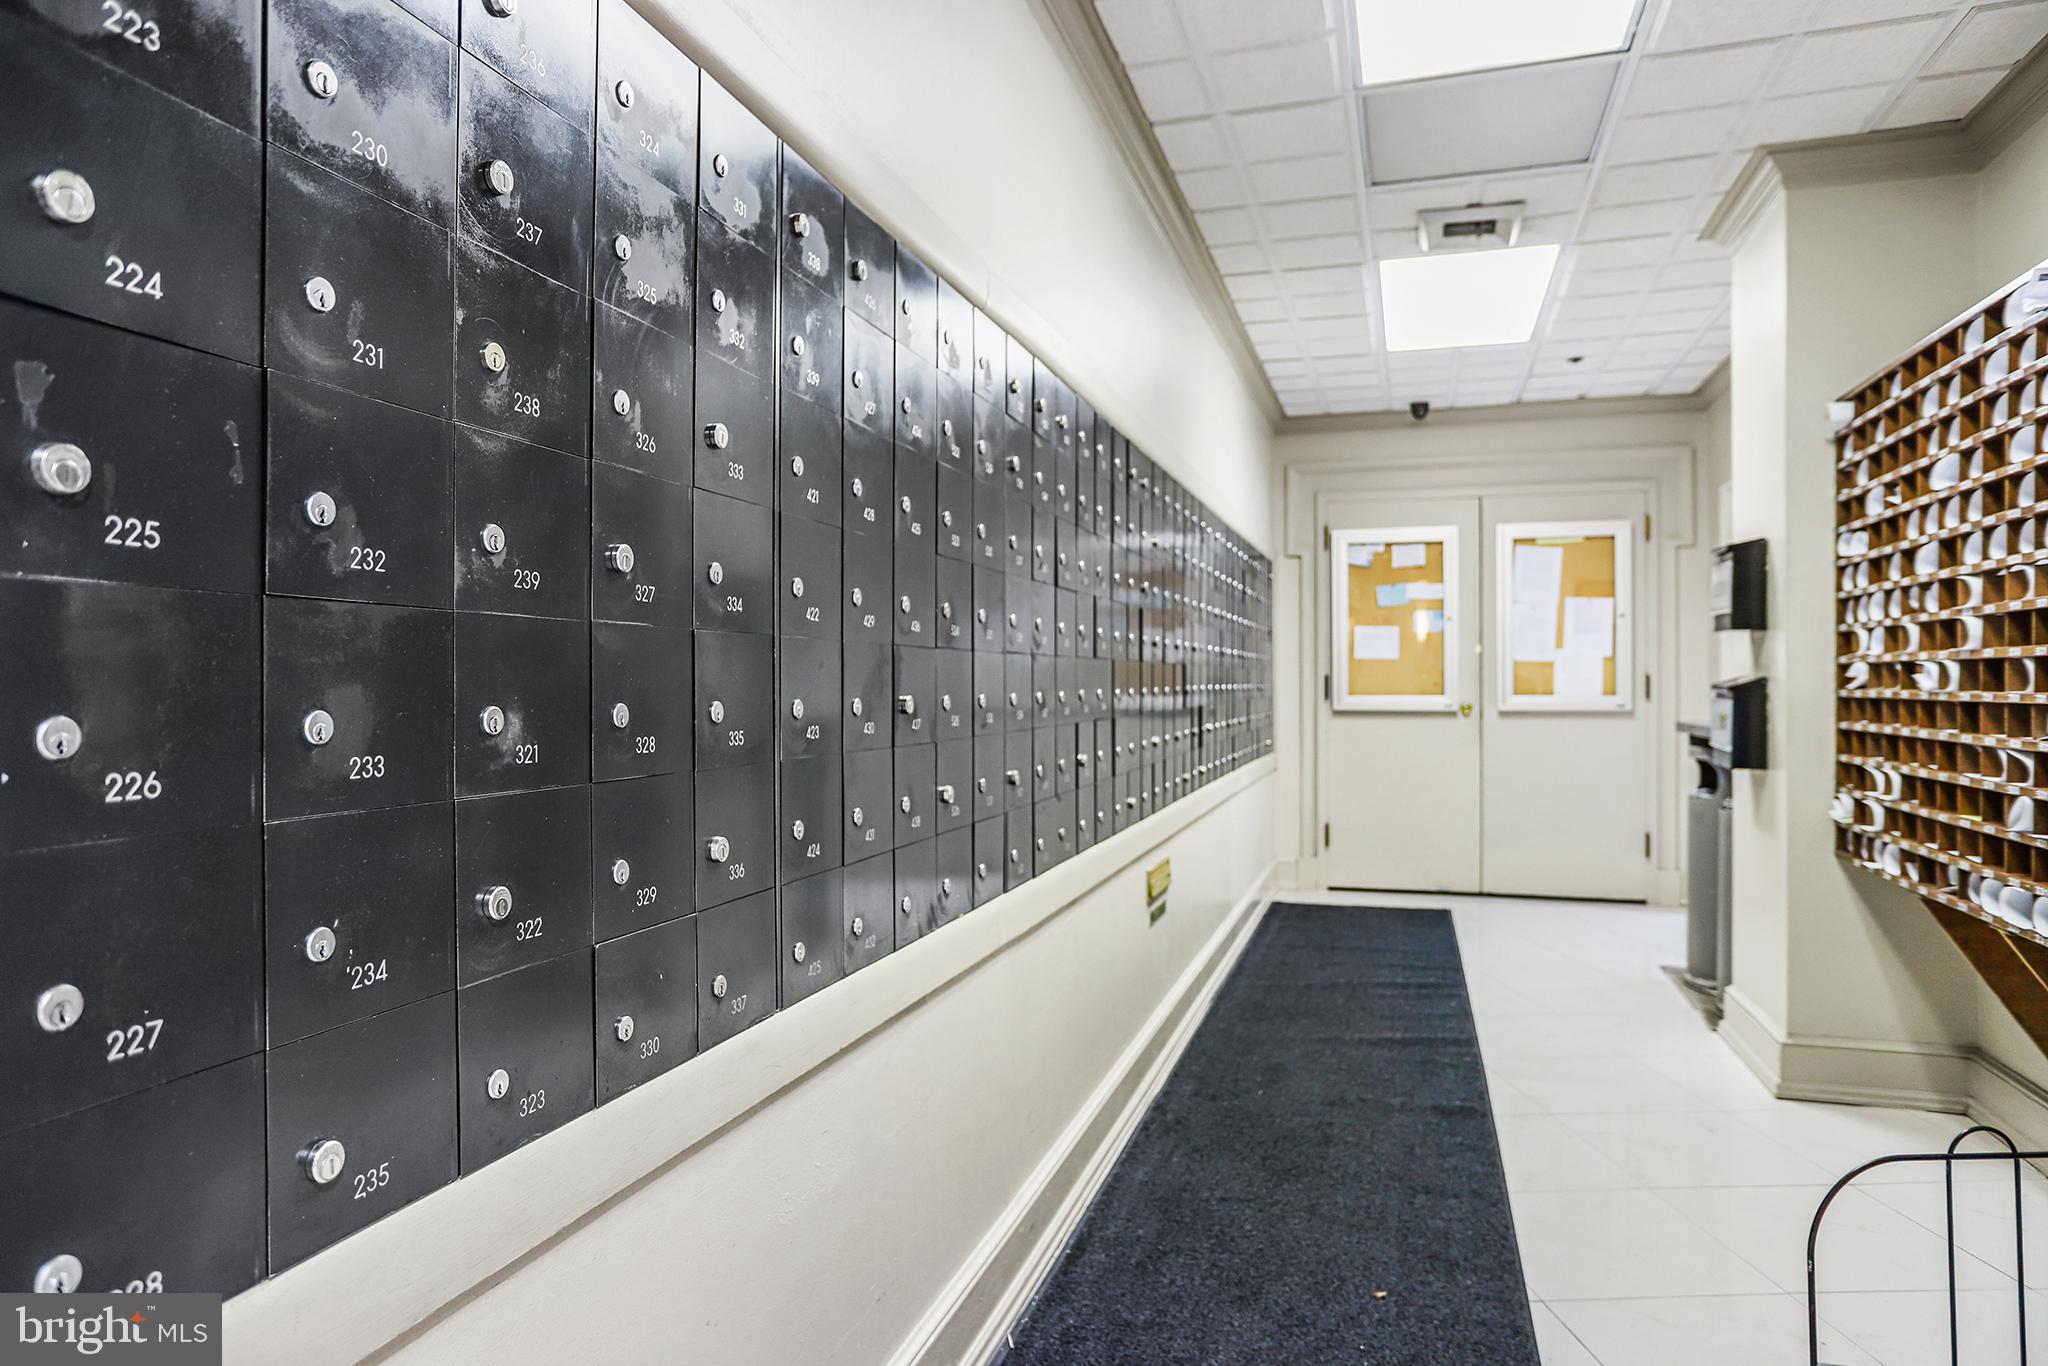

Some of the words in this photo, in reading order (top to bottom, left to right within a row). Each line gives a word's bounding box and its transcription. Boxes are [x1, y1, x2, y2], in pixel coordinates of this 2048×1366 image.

[102, 0, 160, 51] 223
[520, 43, 546, 77] 236
[351, 130, 388, 168] 230
[639, 130, 660, 157] 324
[733, 197, 747, 218] 331
[516, 217, 543, 246] 237
[808, 252, 821, 272] 338
[104, 255, 164, 300] 224
[637, 281, 657, 305] 325
[729, 329, 745, 350] 332
[352, 339, 384, 369] 231
[806, 369, 820, 387] 339
[514, 392, 541, 417] 238
[636, 432, 656, 453] 326
[728, 462, 744, 480] 333
[807, 488, 819, 504] 421
[863, 507, 875, 522] 428
[104, 515, 161, 549] 225
[350, 546, 386, 574] 232
[513, 569, 541, 590] 239
[635, 585, 656, 603] 327
[727, 596, 743, 612] 334
[806, 607, 819, 622] 422
[863, 614, 875, 628] 429
[806, 725, 820, 740] 423
[863, 721, 875, 735] 430
[635, 737, 656, 754] 328
[728, 731, 744, 747] 335
[515, 746, 539, 764] 321
[349, 756, 385, 780] 233
[104, 771, 162, 803] 226
[911, 815, 921, 828] 438
[865, 828, 875, 842] 431
[807, 843, 821, 858] 424
[729, 863, 745, 881] 336
[636, 887, 657, 907] 329
[516, 917, 543, 942] 322
[351, 959, 389, 990] 234
[808, 960, 822, 976] 425
[731, 994, 747, 1015] 337
[106, 1019, 164, 1063] 227
[640, 1036, 660, 1060] 330
[519, 1089, 546, 1118] 323
[354, 1163, 390, 1200] 235
